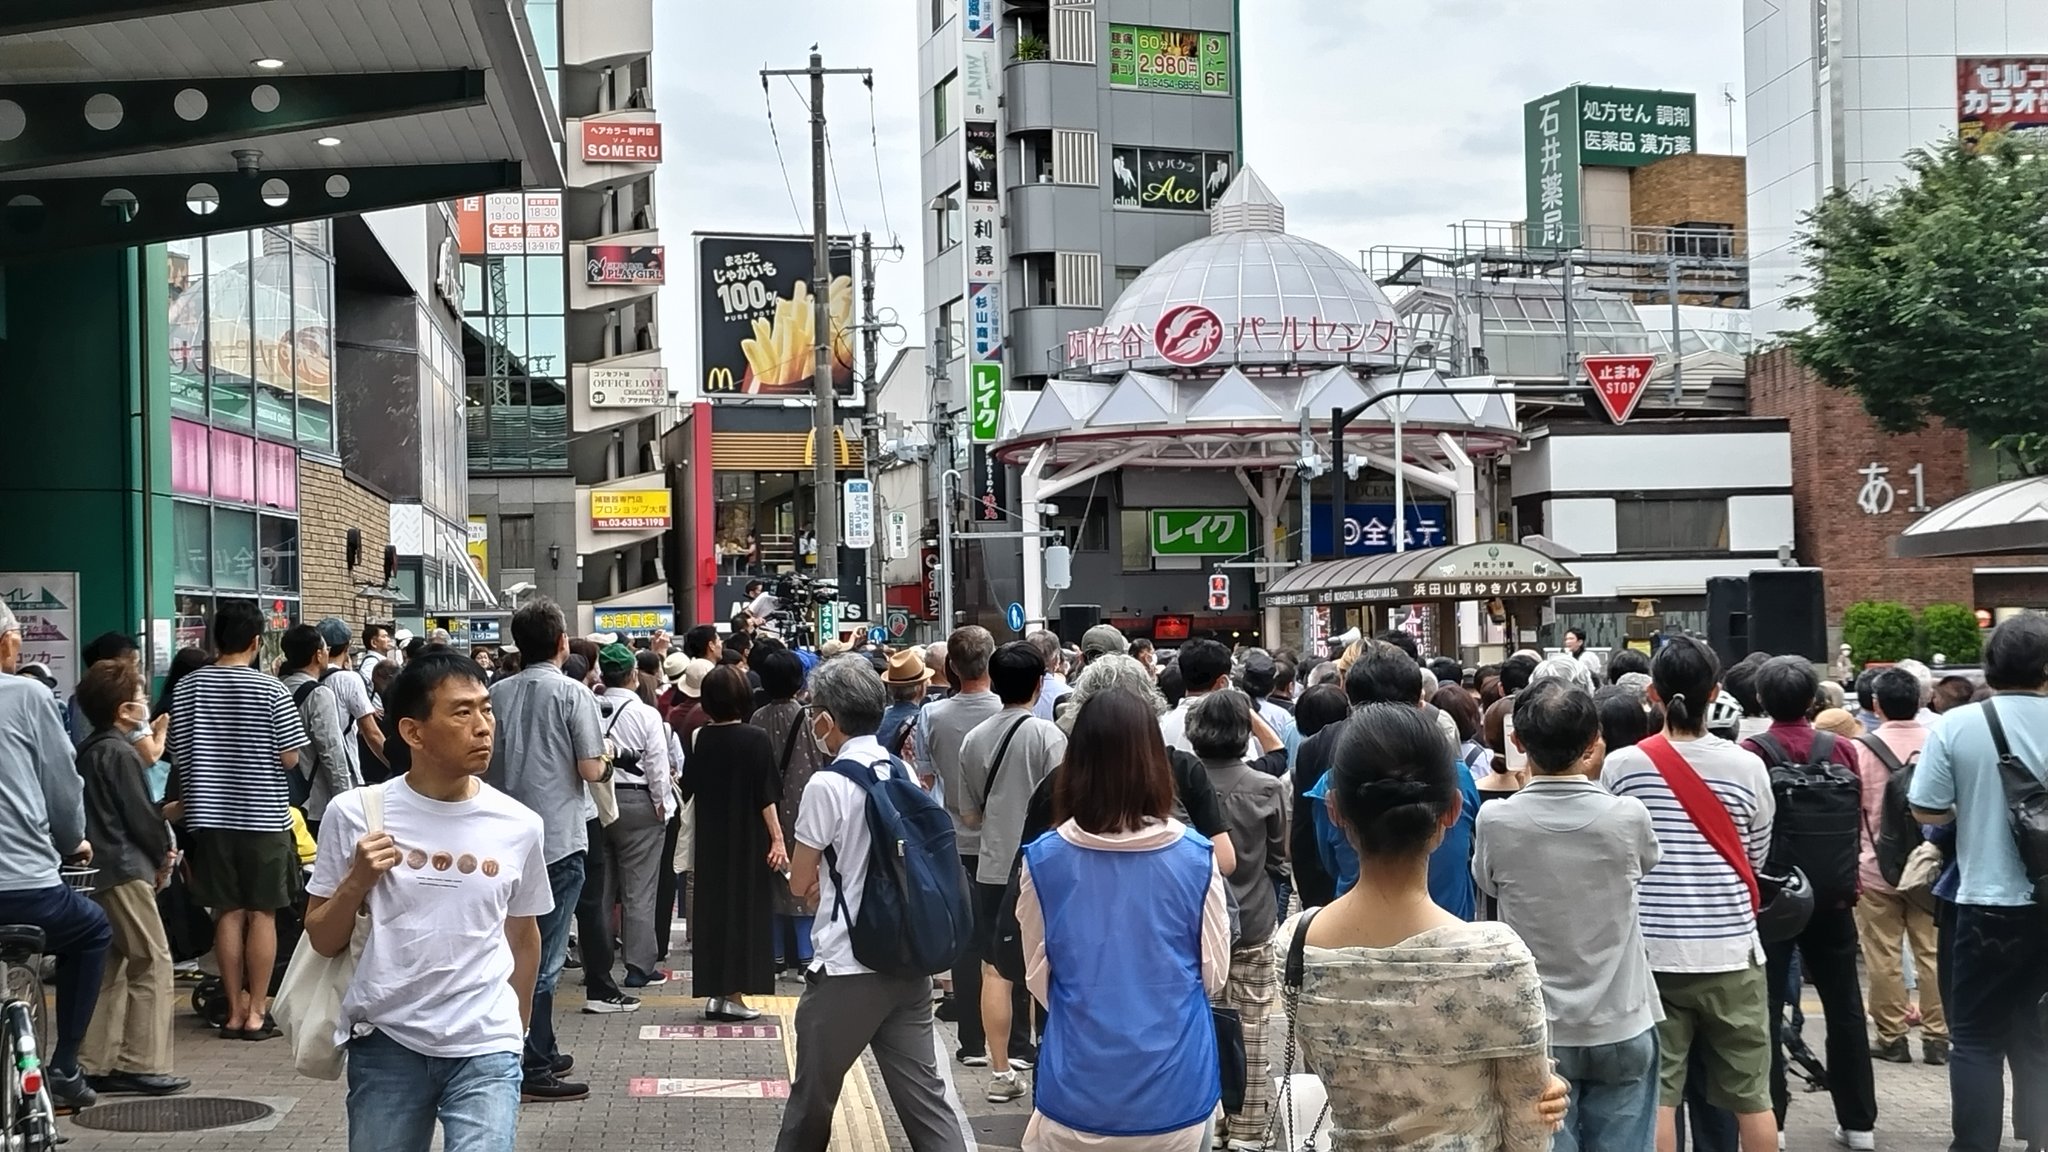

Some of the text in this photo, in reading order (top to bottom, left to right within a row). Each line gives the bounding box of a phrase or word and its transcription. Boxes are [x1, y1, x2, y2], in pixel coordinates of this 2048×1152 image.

[1139, 34, 1168, 50] 60分
[1139, 53, 1198, 78] 2,980円
[1204, 71, 1226, 87] 6F
[1583, 99, 1690, 127] 処方せん 調剤
[590, 126, 655, 137] ヘアカラー専門店
[1584, 129, 1692, 155] 医薬品 漢方薬
[587, 144, 659, 158] SOMERU
[1539, 99, 1564, 247] 石井薬局
[974, 181, 992, 192] 5F
[1142, 175, 1200, 204] Ace
[489, 196, 520, 206] 10:00
[1114, 195, 1138, 206] club
[489, 211, 521, 221] 19:00
[491, 224, 559, 238] 年中無休
[973, 218, 995, 266] 利嘉
[724, 251, 761, 267] まるごと
[607, 269, 664, 280] PLAYGIRL
[713, 261, 777, 284] じゃがいも
[974, 269, 995, 277] 4F
[717, 279, 778, 315] 100%
[724, 313, 749, 323] PURE
[976, 296, 989, 355] 杉山商事
[1067, 321, 1152, 363] 阿佐谷
[1598, 364, 1642, 380] 止まれ
[593, 379, 664, 388] OFFICE LOVE
[1606, 381, 1636, 395] STOP
[976, 371, 997, 429] レイク
[1857, 461, 1932, 515] あ-1
[595, 505, 667, 515] プロショップ大塚
[1159, 515, 1236, 545] レイク
[1413, 581, 1578, 597] 浜田山駅ゆきバスのりば
[601, 612, 667, 629] お部屋探し
